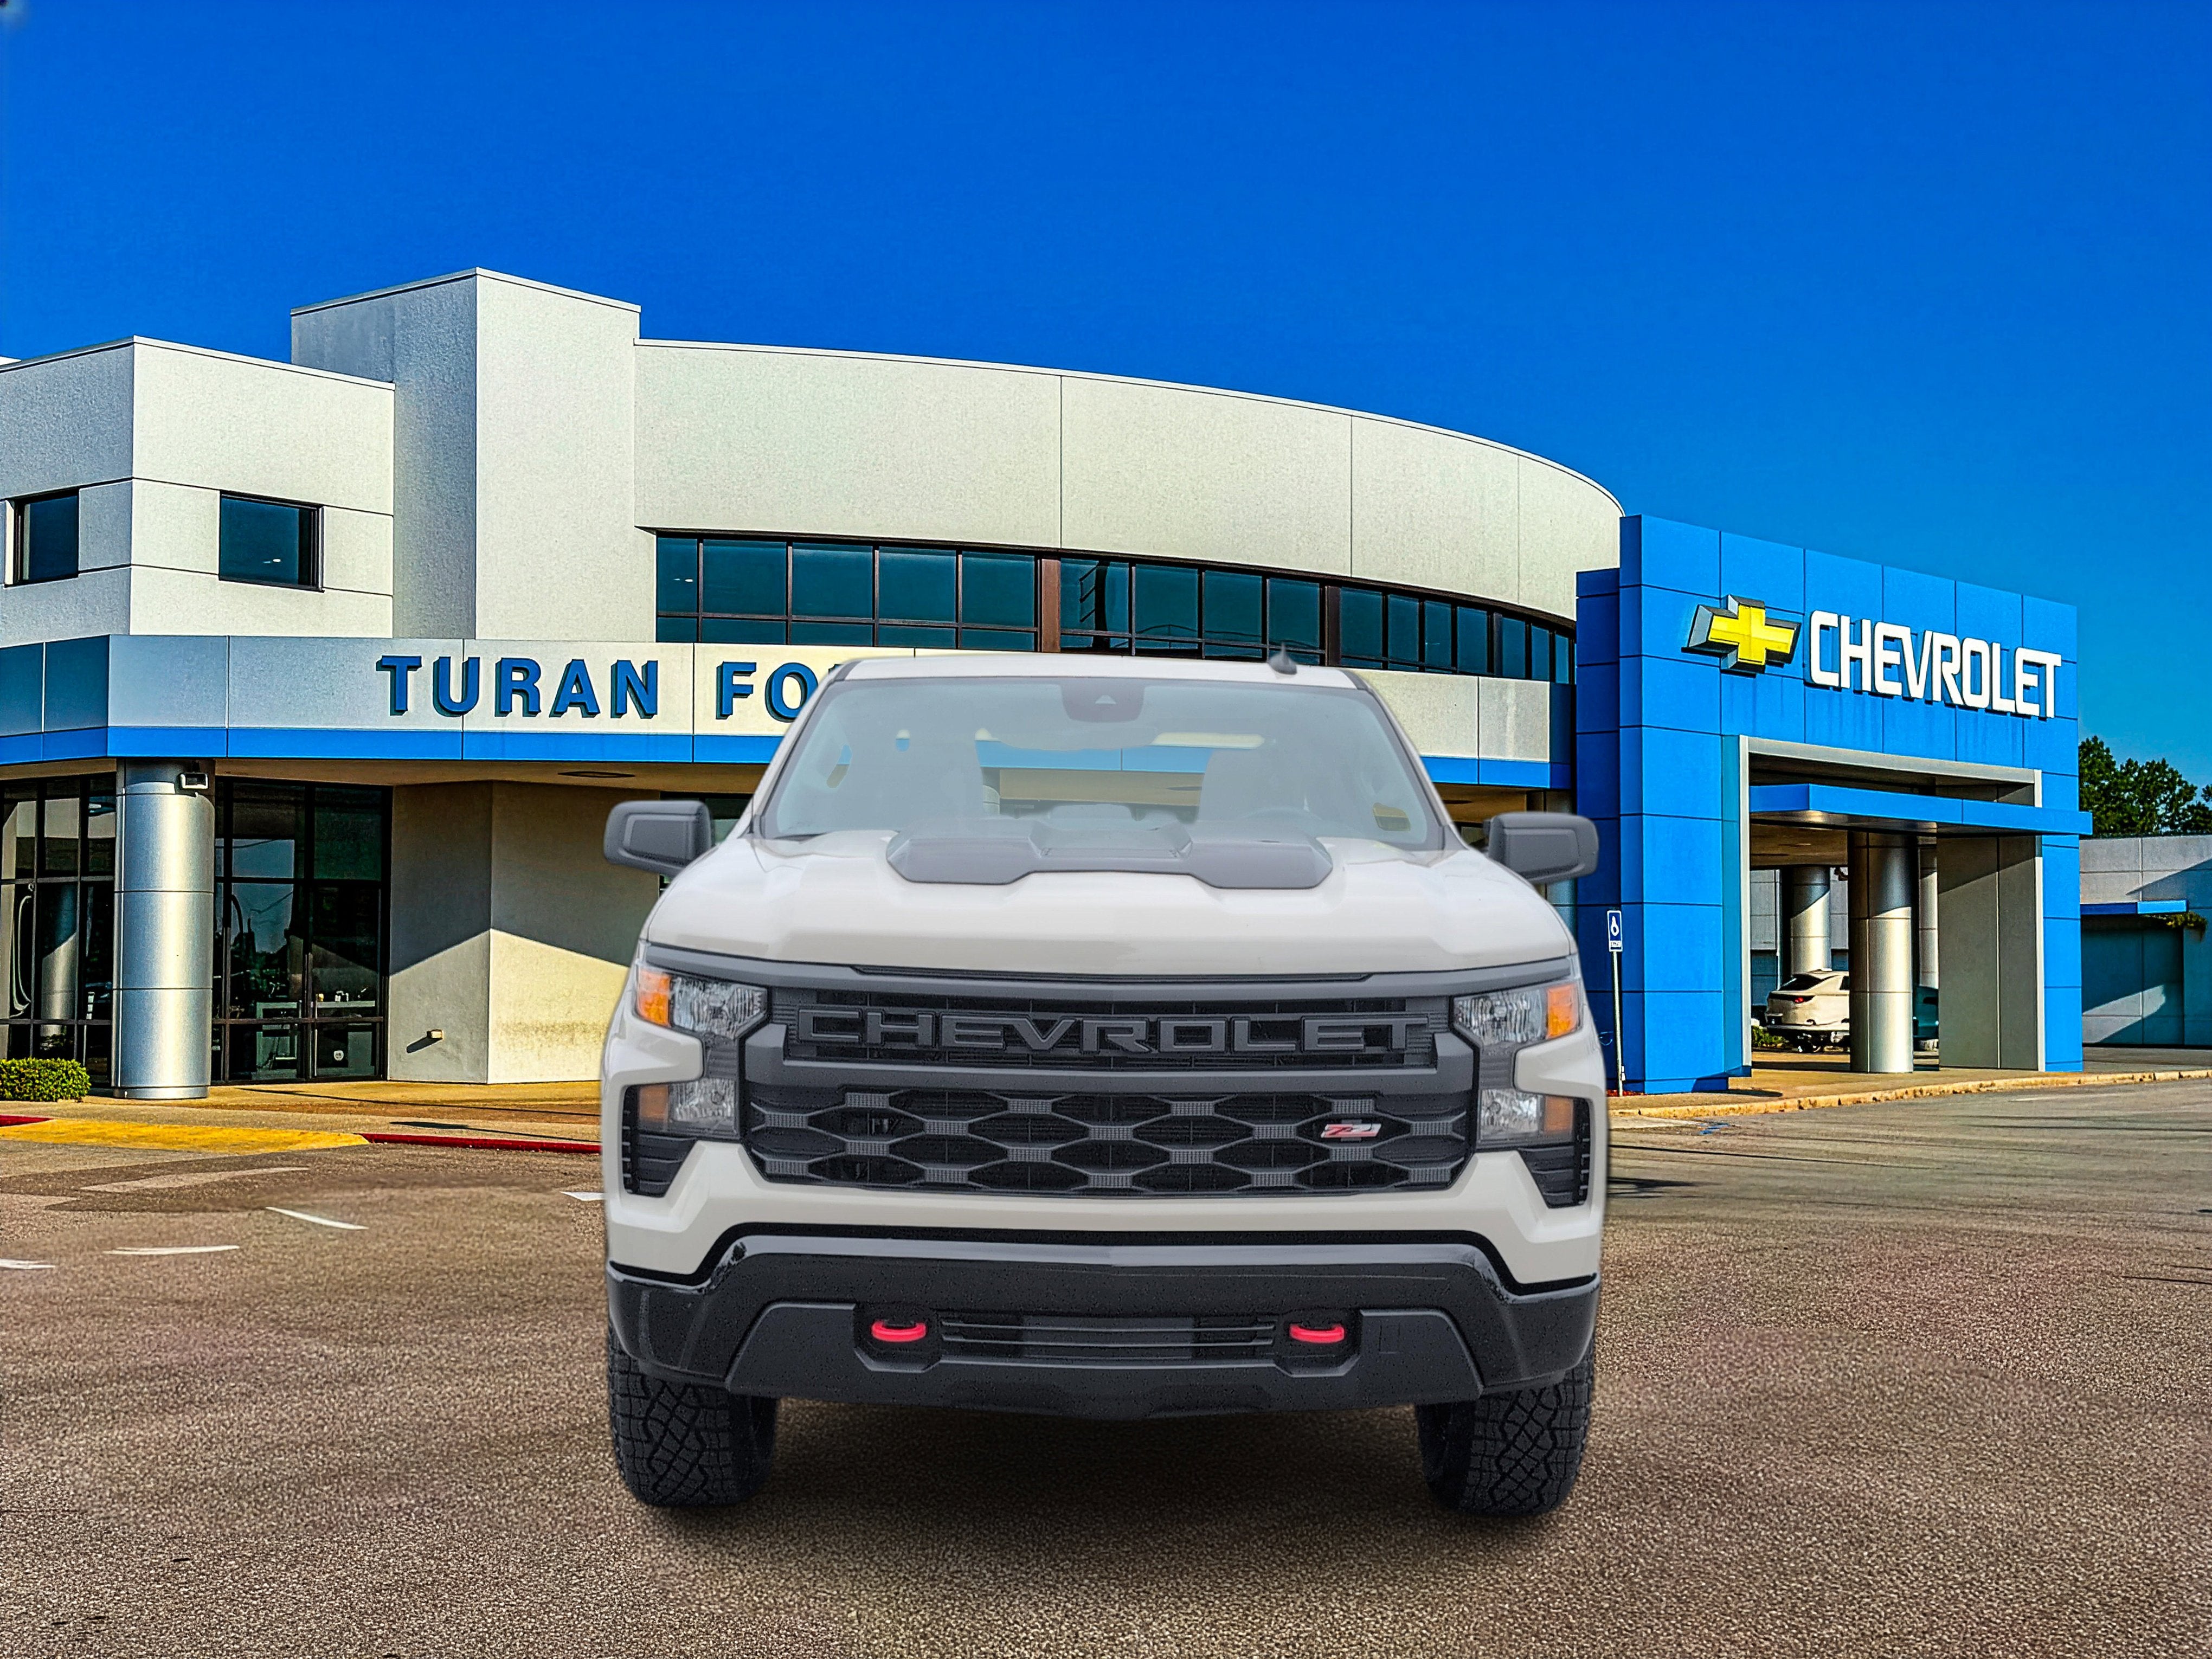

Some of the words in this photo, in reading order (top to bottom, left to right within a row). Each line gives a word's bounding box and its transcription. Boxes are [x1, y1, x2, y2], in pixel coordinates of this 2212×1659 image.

[376, 655, 658, 718] TURAN
[716, 661, 844, 723] FO
[1810, 610, 2062, 718] CHEVROLET
[798, 1008, 1429, 1053] CHEVROLET
